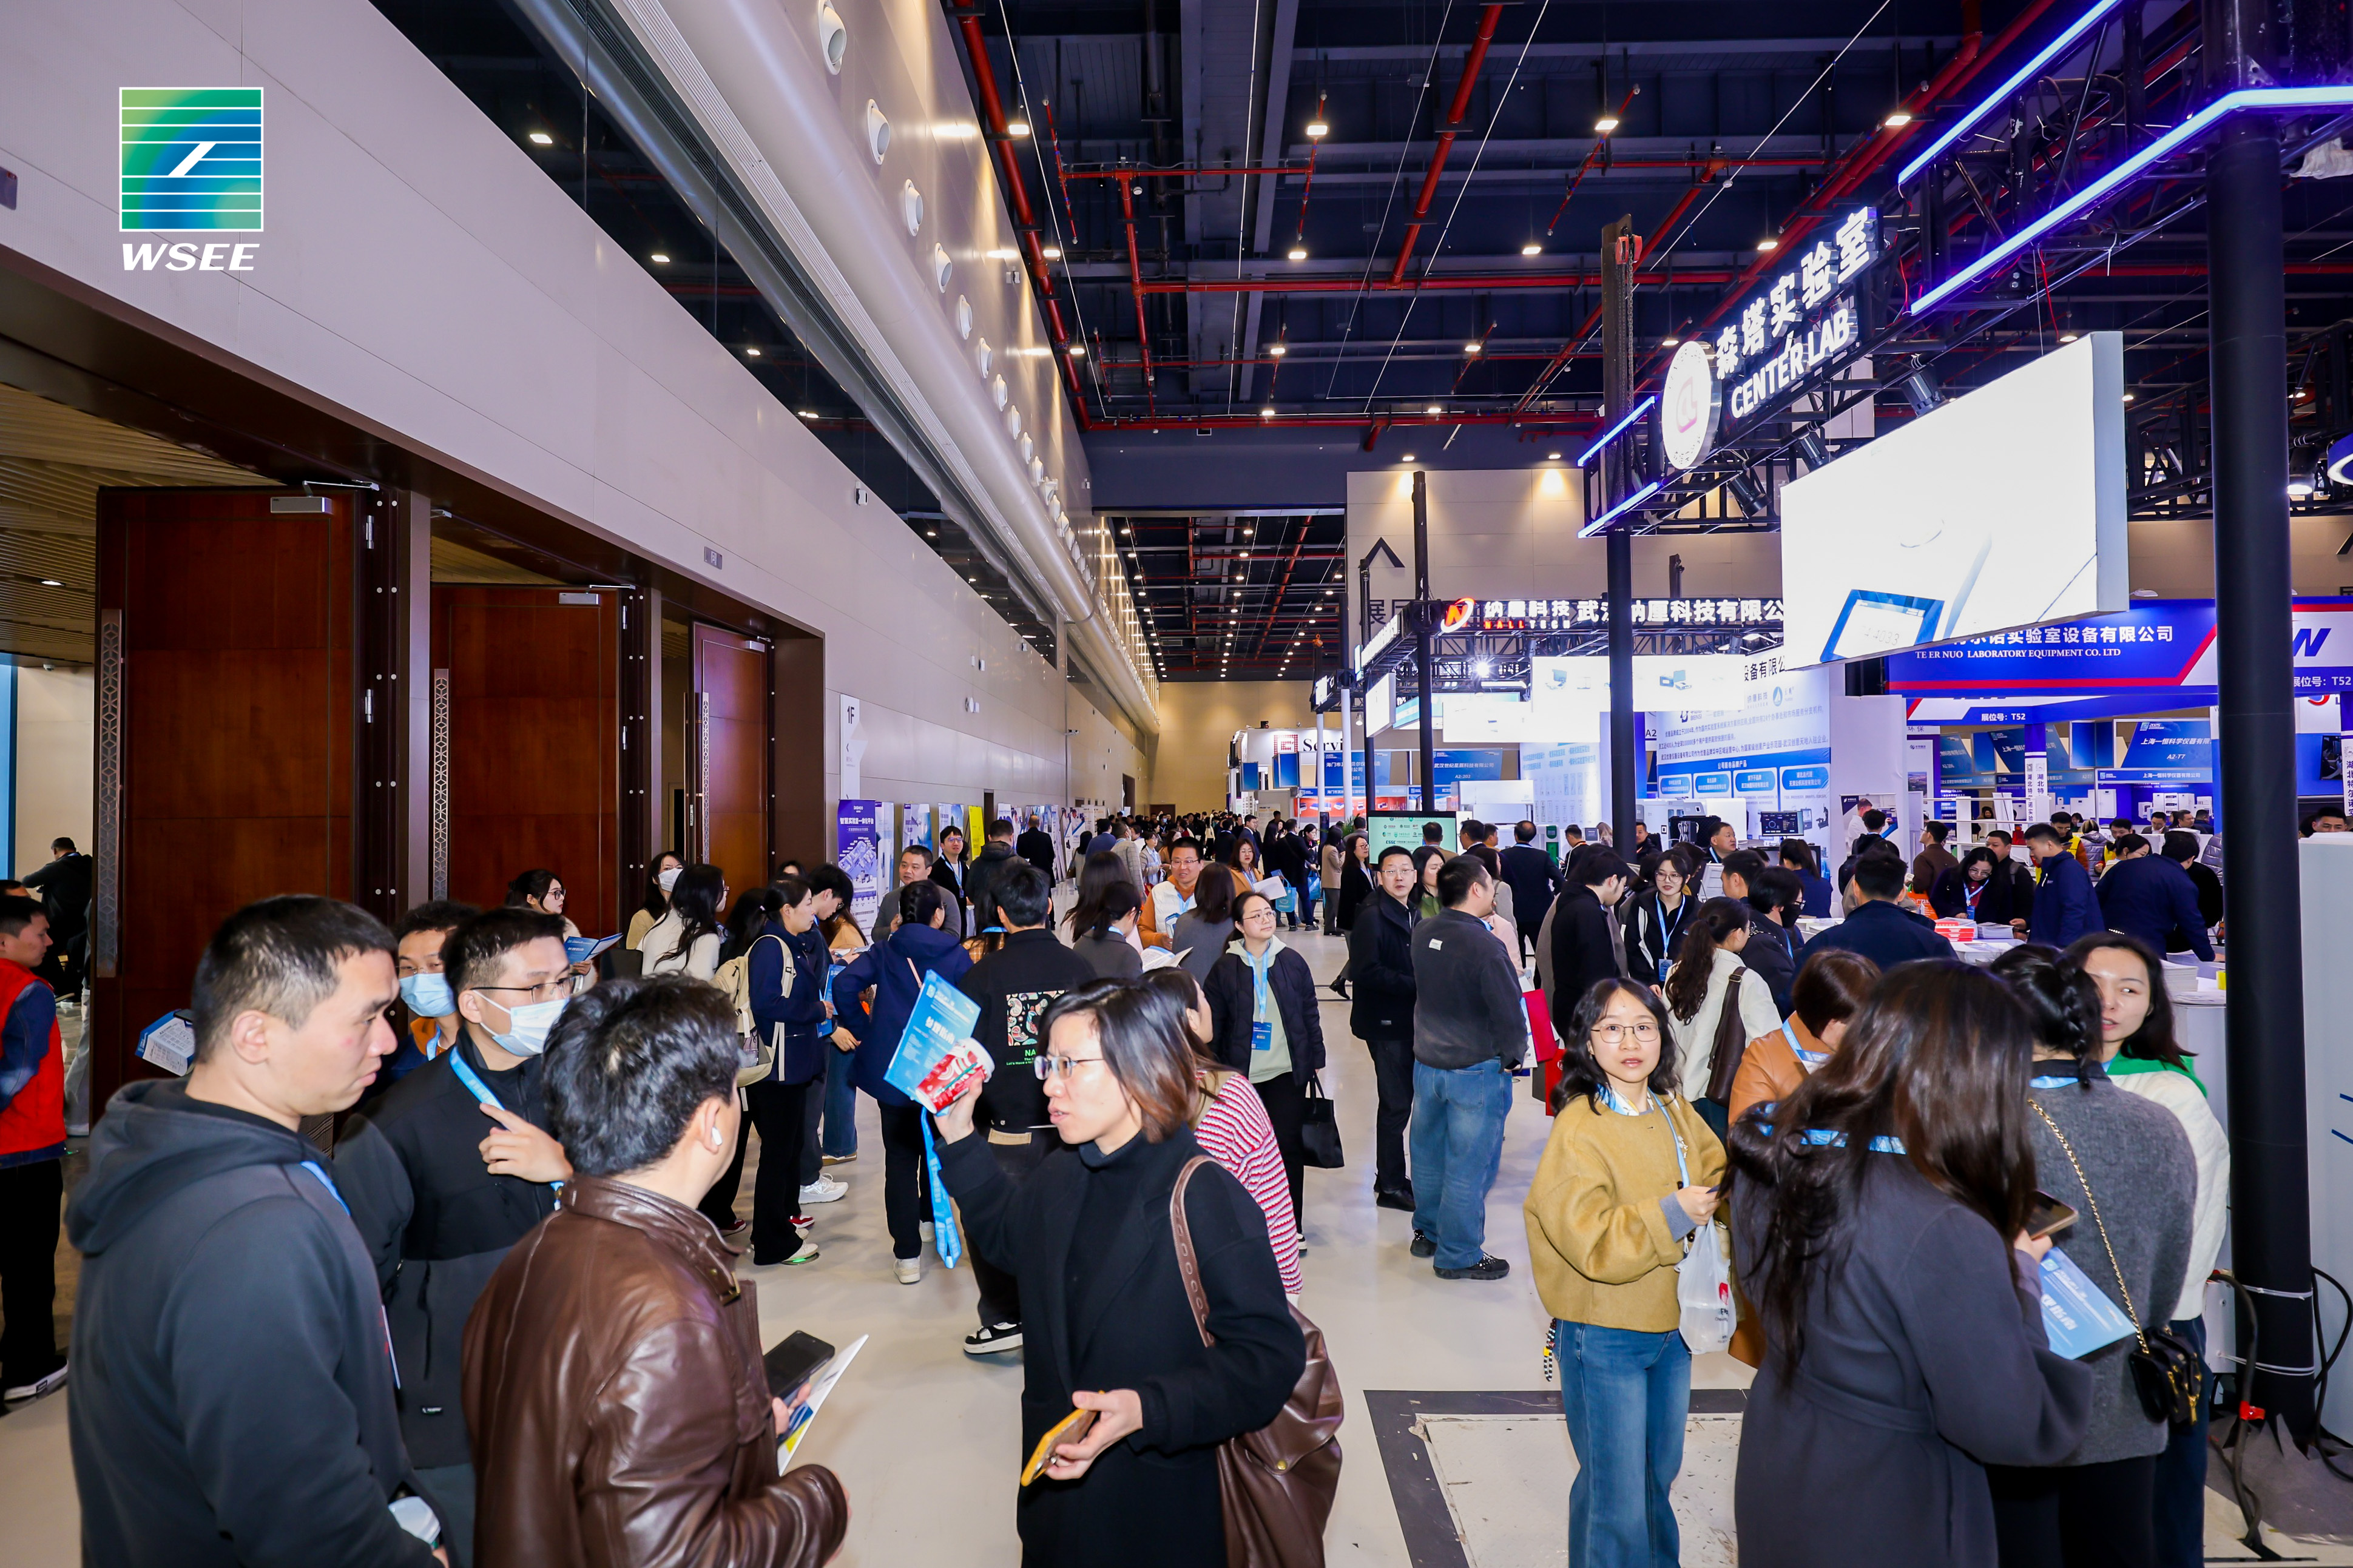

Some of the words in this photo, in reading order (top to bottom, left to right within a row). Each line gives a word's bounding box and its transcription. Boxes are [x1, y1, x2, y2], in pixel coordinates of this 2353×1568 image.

[1717, 206, 1870, 380] 森塔实验室
[1731, 343, 1804, 419] CENTER
[1808, 308, 1850, 366] LAB
[1942, 650, 1963, 659] NUO
[1967, 650, 2027, 658] LABORATORY
[2028, 649, 2083, 659] EQUIPMENT
[847, 705, 855, 724] 1F
